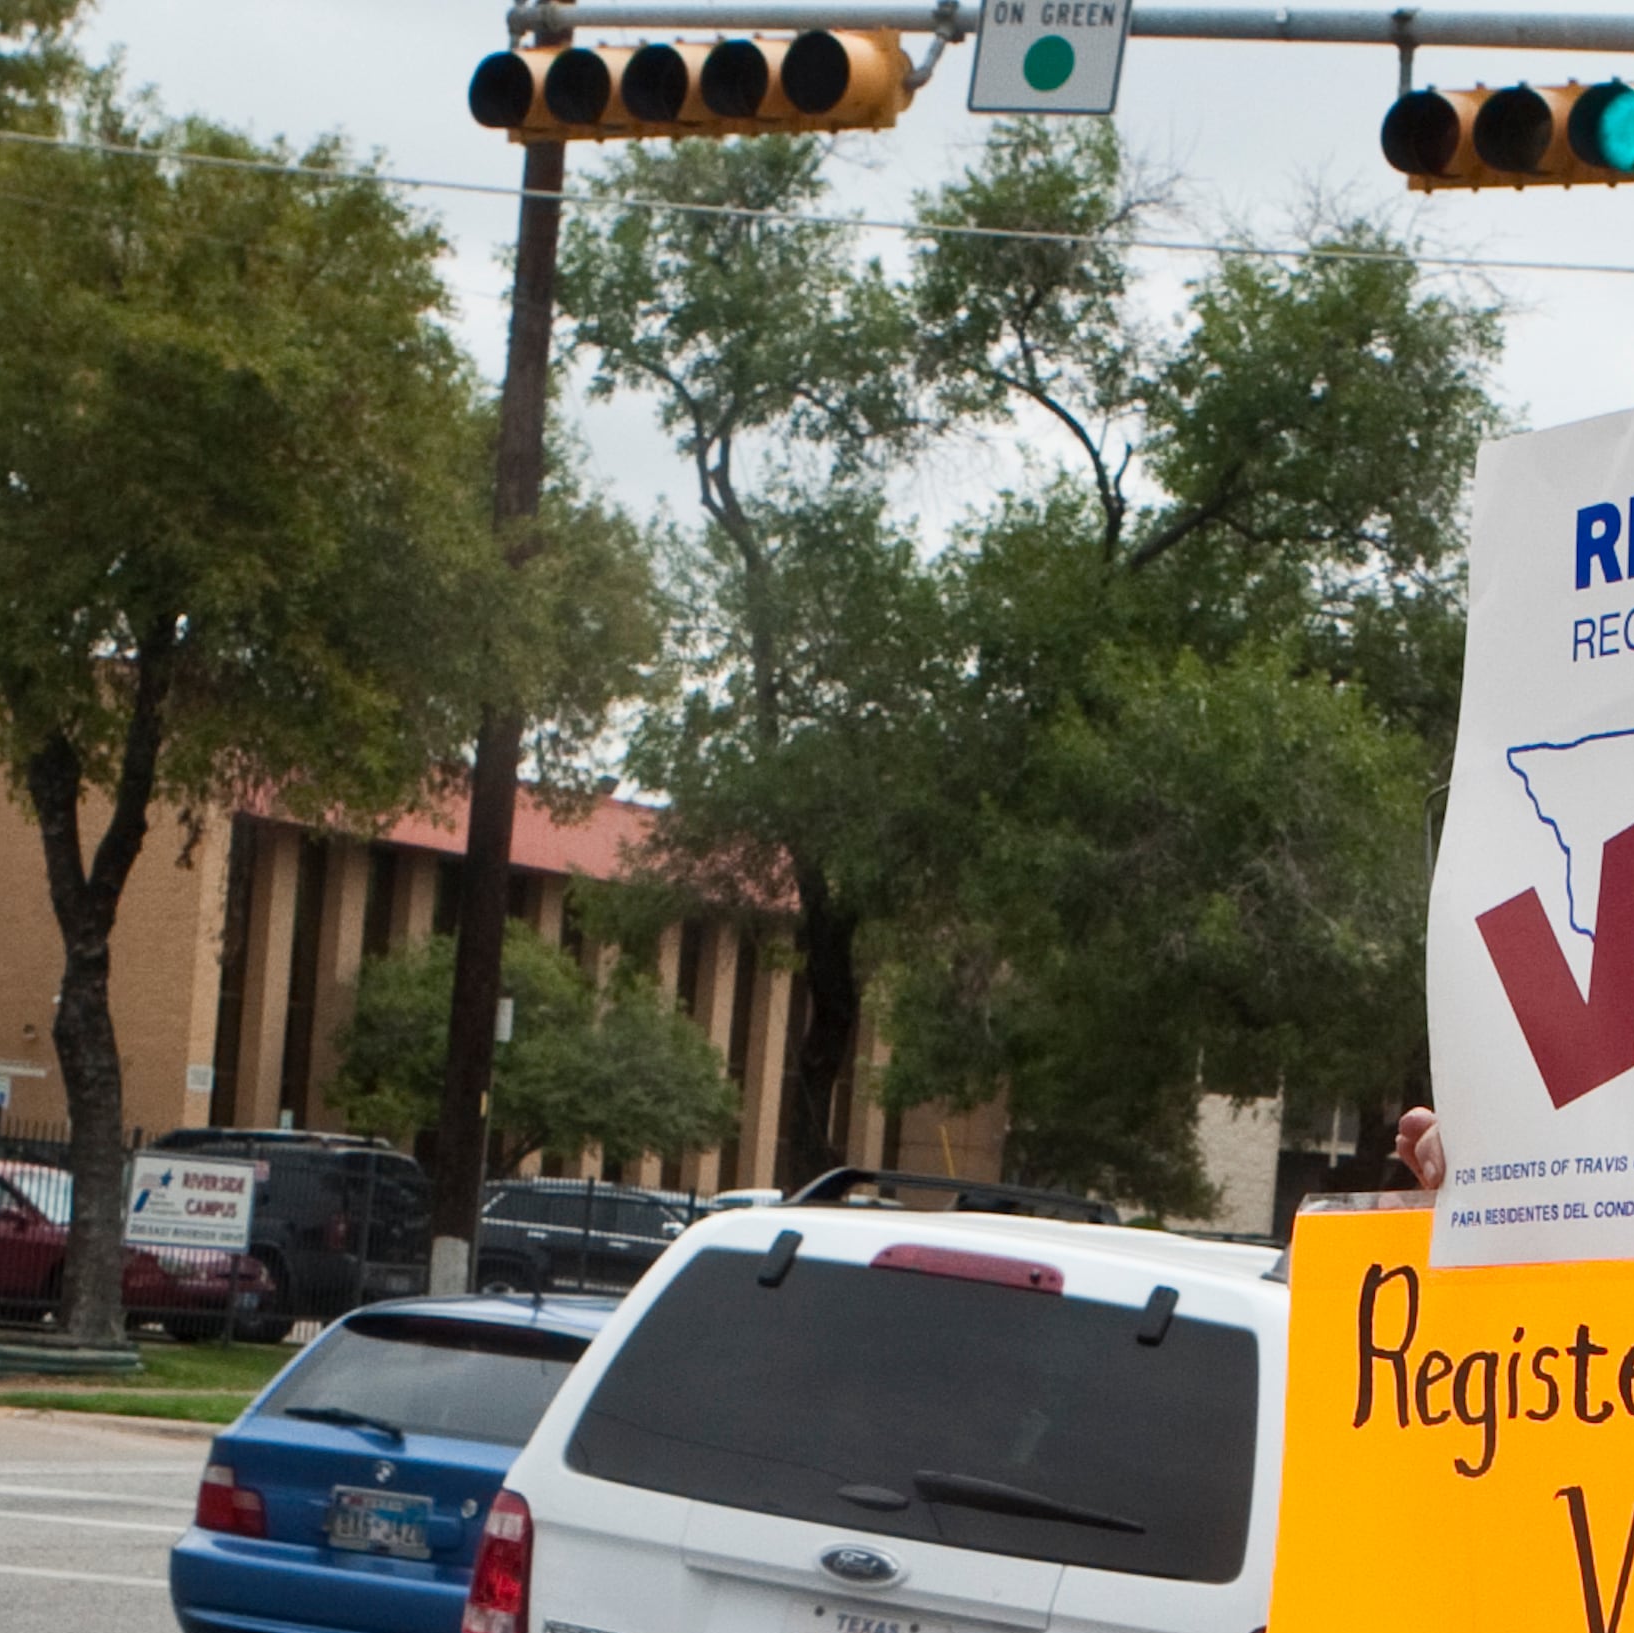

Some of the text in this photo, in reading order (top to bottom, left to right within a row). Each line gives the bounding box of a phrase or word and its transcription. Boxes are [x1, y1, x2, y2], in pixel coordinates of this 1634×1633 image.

[993, 1, 1116, 27] ON GREEN
[1455, 1169, 1476, 1187] FOR
[1481, 1160, 1547, 1183] RESIDENTS
[1551, 1158, 1570, 1177] OF
[1574, 1155, 1628, 1175] TRAVIS
[184, 1198, 238, 1219] CAMPUS
[1451, 1209, 1482, 1228] PARA
[1485, 1203, 1560, 1226] RESIDENTES
[1563, 1202, 1589, 1220] DEL
